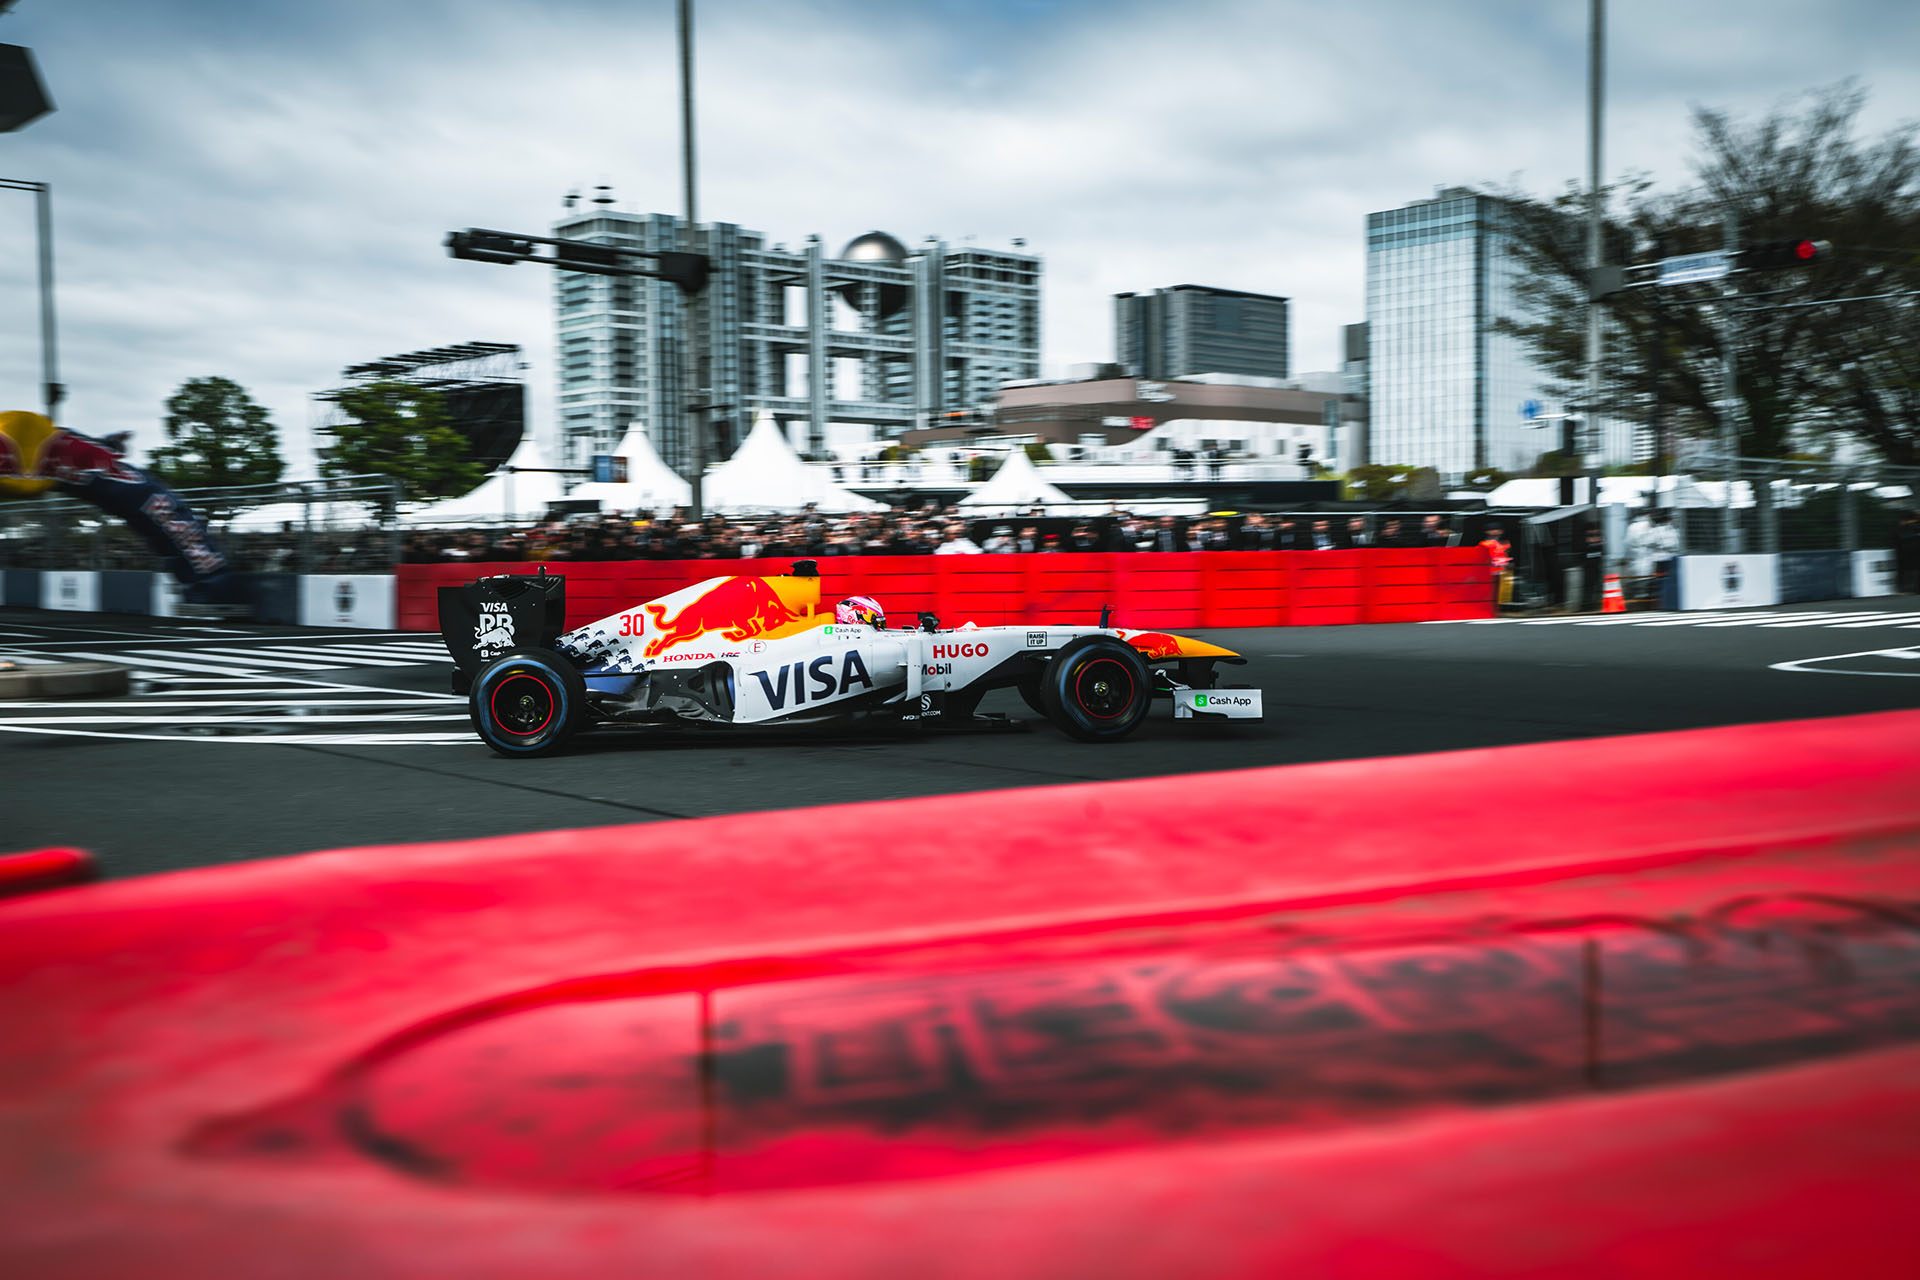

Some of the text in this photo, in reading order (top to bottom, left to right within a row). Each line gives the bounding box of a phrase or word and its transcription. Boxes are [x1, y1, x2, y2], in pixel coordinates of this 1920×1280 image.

[480, 602, 508, 612] VISA
[618, 613, 645, 637] 30
[753, 642, 761, 653] E
[932, 642, 989, 659] HUGO
[663, 652, 716, 662] HONDA
[747, 649, 874, 711] VISA
[1209, 696, 1252, 706] Cash App
